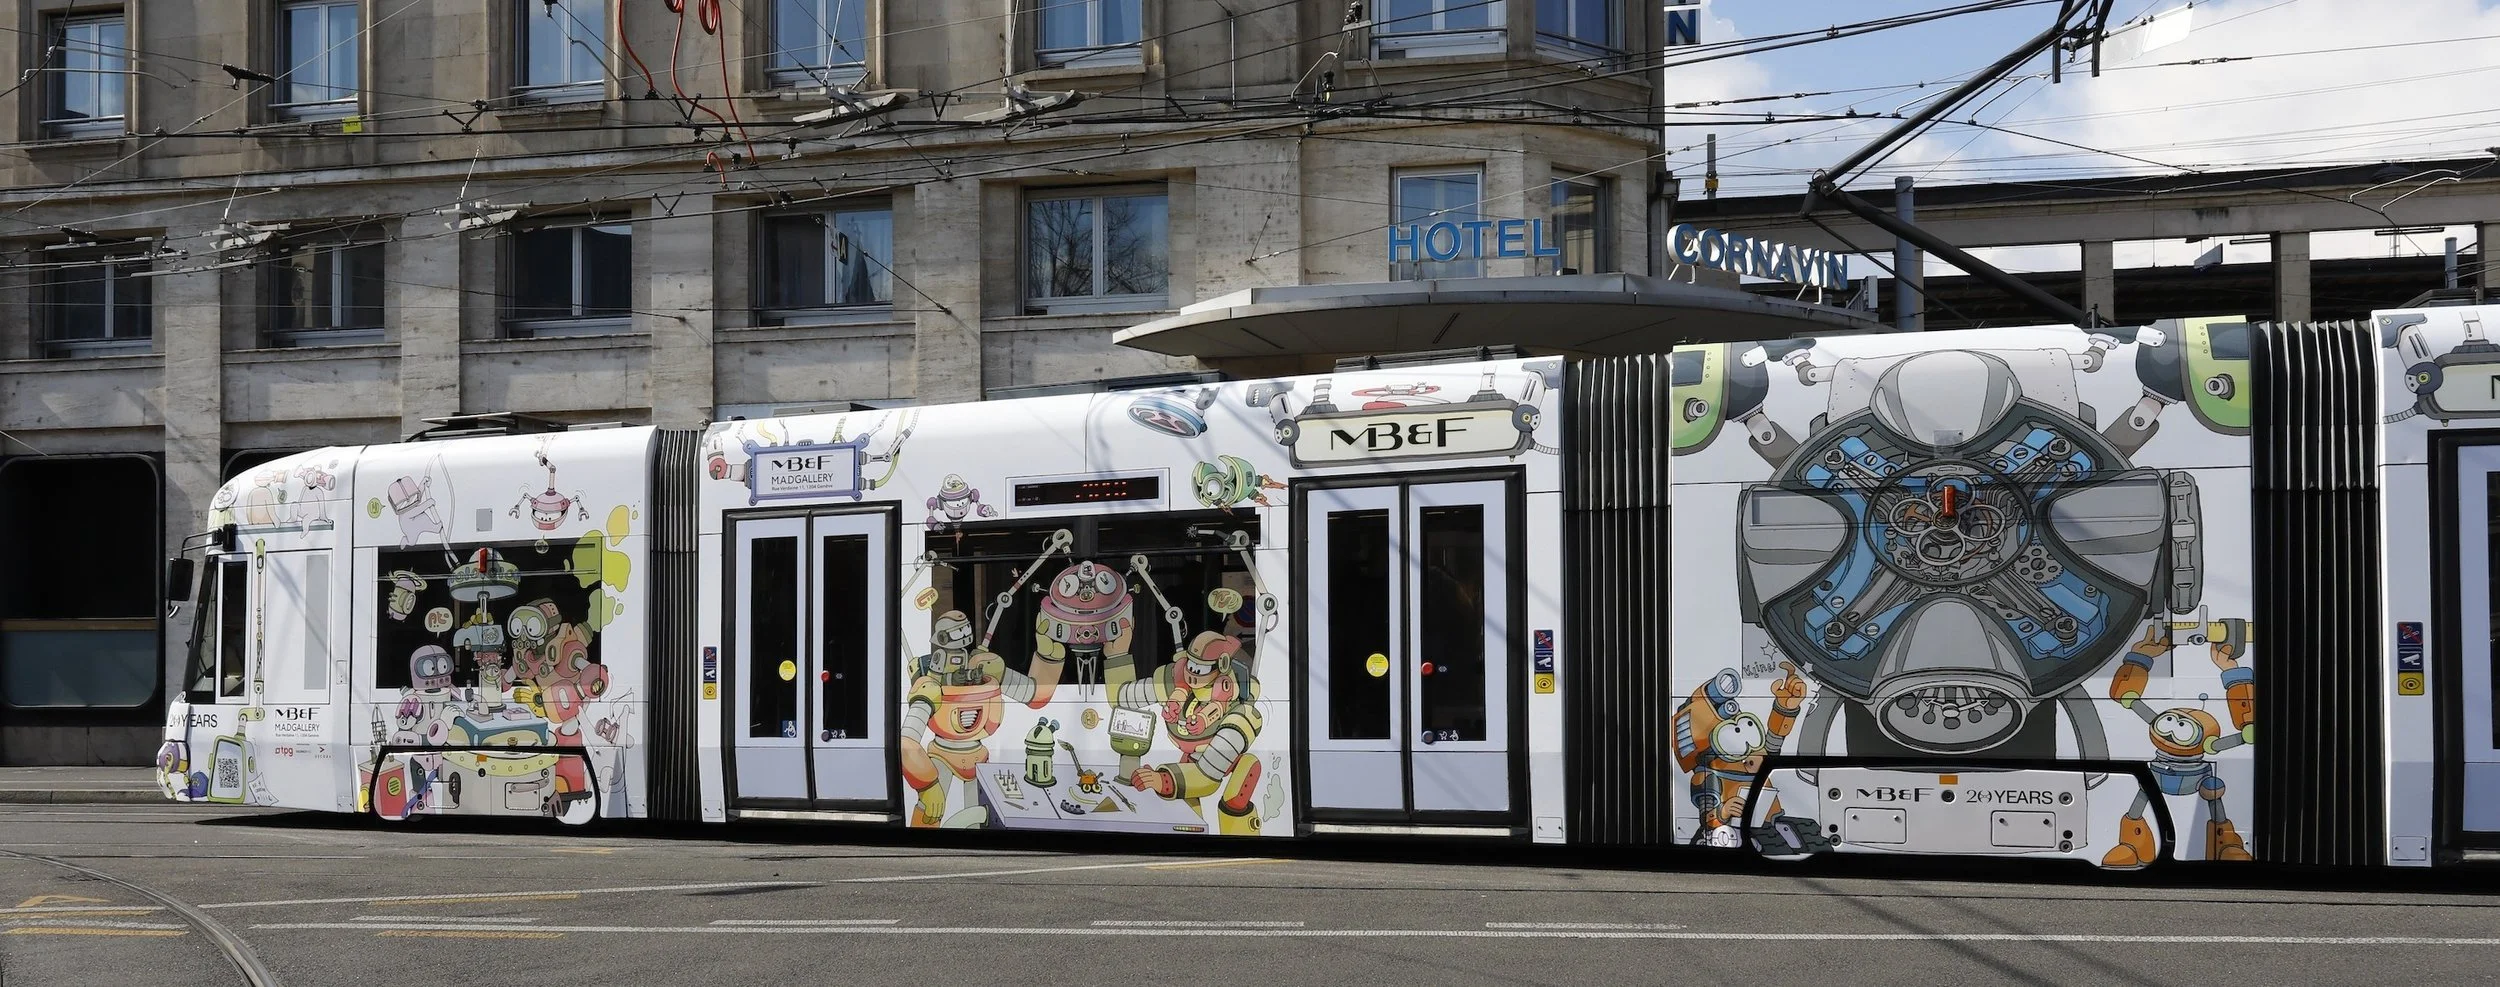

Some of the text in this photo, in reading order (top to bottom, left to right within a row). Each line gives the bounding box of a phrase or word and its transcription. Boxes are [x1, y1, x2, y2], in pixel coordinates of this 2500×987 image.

[1388, 218, 1848, 290] HOTEL CORNAVIN
[1331, 417, 1474, 451] MB&F
[772, 455, 834, 471] MB&F
[275, 707, 320, 720] MB&F
[1856, 787, 1934, 802] MB&F
